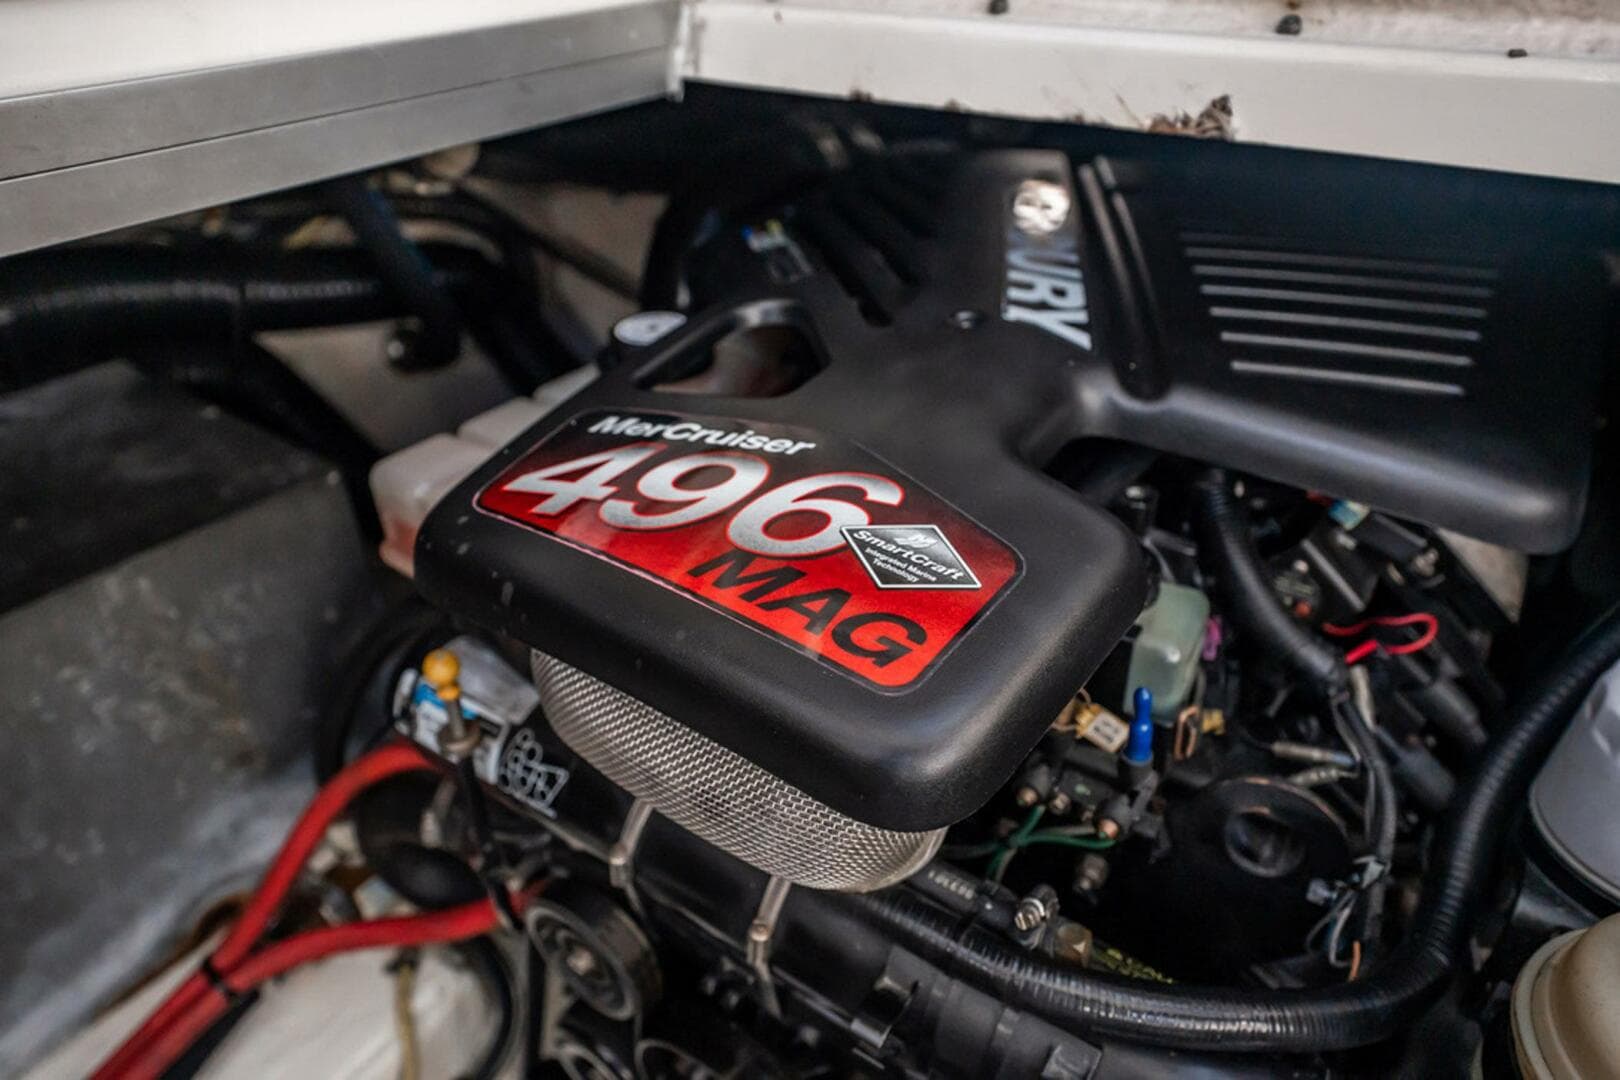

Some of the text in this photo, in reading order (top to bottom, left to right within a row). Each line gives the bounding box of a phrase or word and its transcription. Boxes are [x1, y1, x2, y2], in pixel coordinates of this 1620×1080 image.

[1002, 230, 1092, 351] URY
[587, 414, 816, 456] MerCruiser
[502, 441, 905, 558] 496
[853, 529, 965, 581] SmartCraft
[864, 547, 937, 582] Integrated Marine
[872, 557, 920, 583] Technology
[687, 551, 929, 669] MAG
